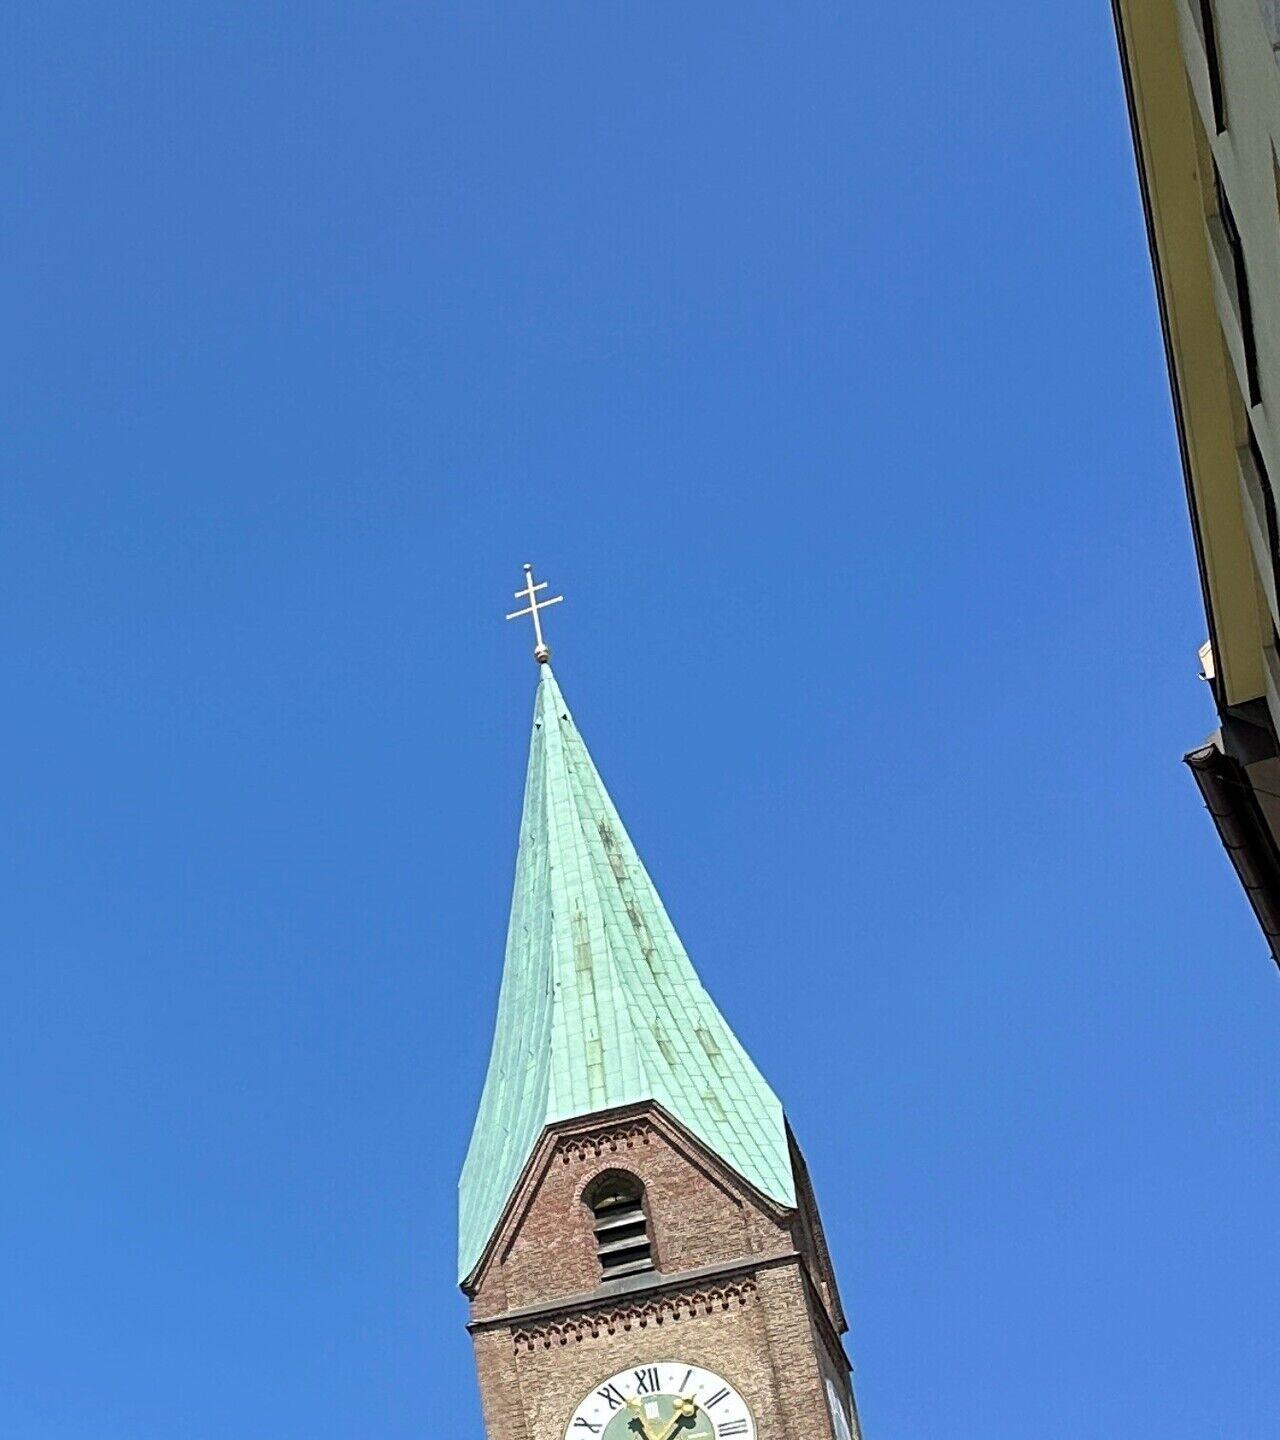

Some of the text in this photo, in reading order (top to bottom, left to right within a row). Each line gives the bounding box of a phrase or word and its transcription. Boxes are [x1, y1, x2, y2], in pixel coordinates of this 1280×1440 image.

[634, 1367, 660, 1394] XII
[679, 1369, 692, 1392] I
[597, 1383, 626, 1410] XI
[703, 1387, 730, 1409] II
[573, 1417, 602, 1433] X
[717, 1419, 748, 1437] III
